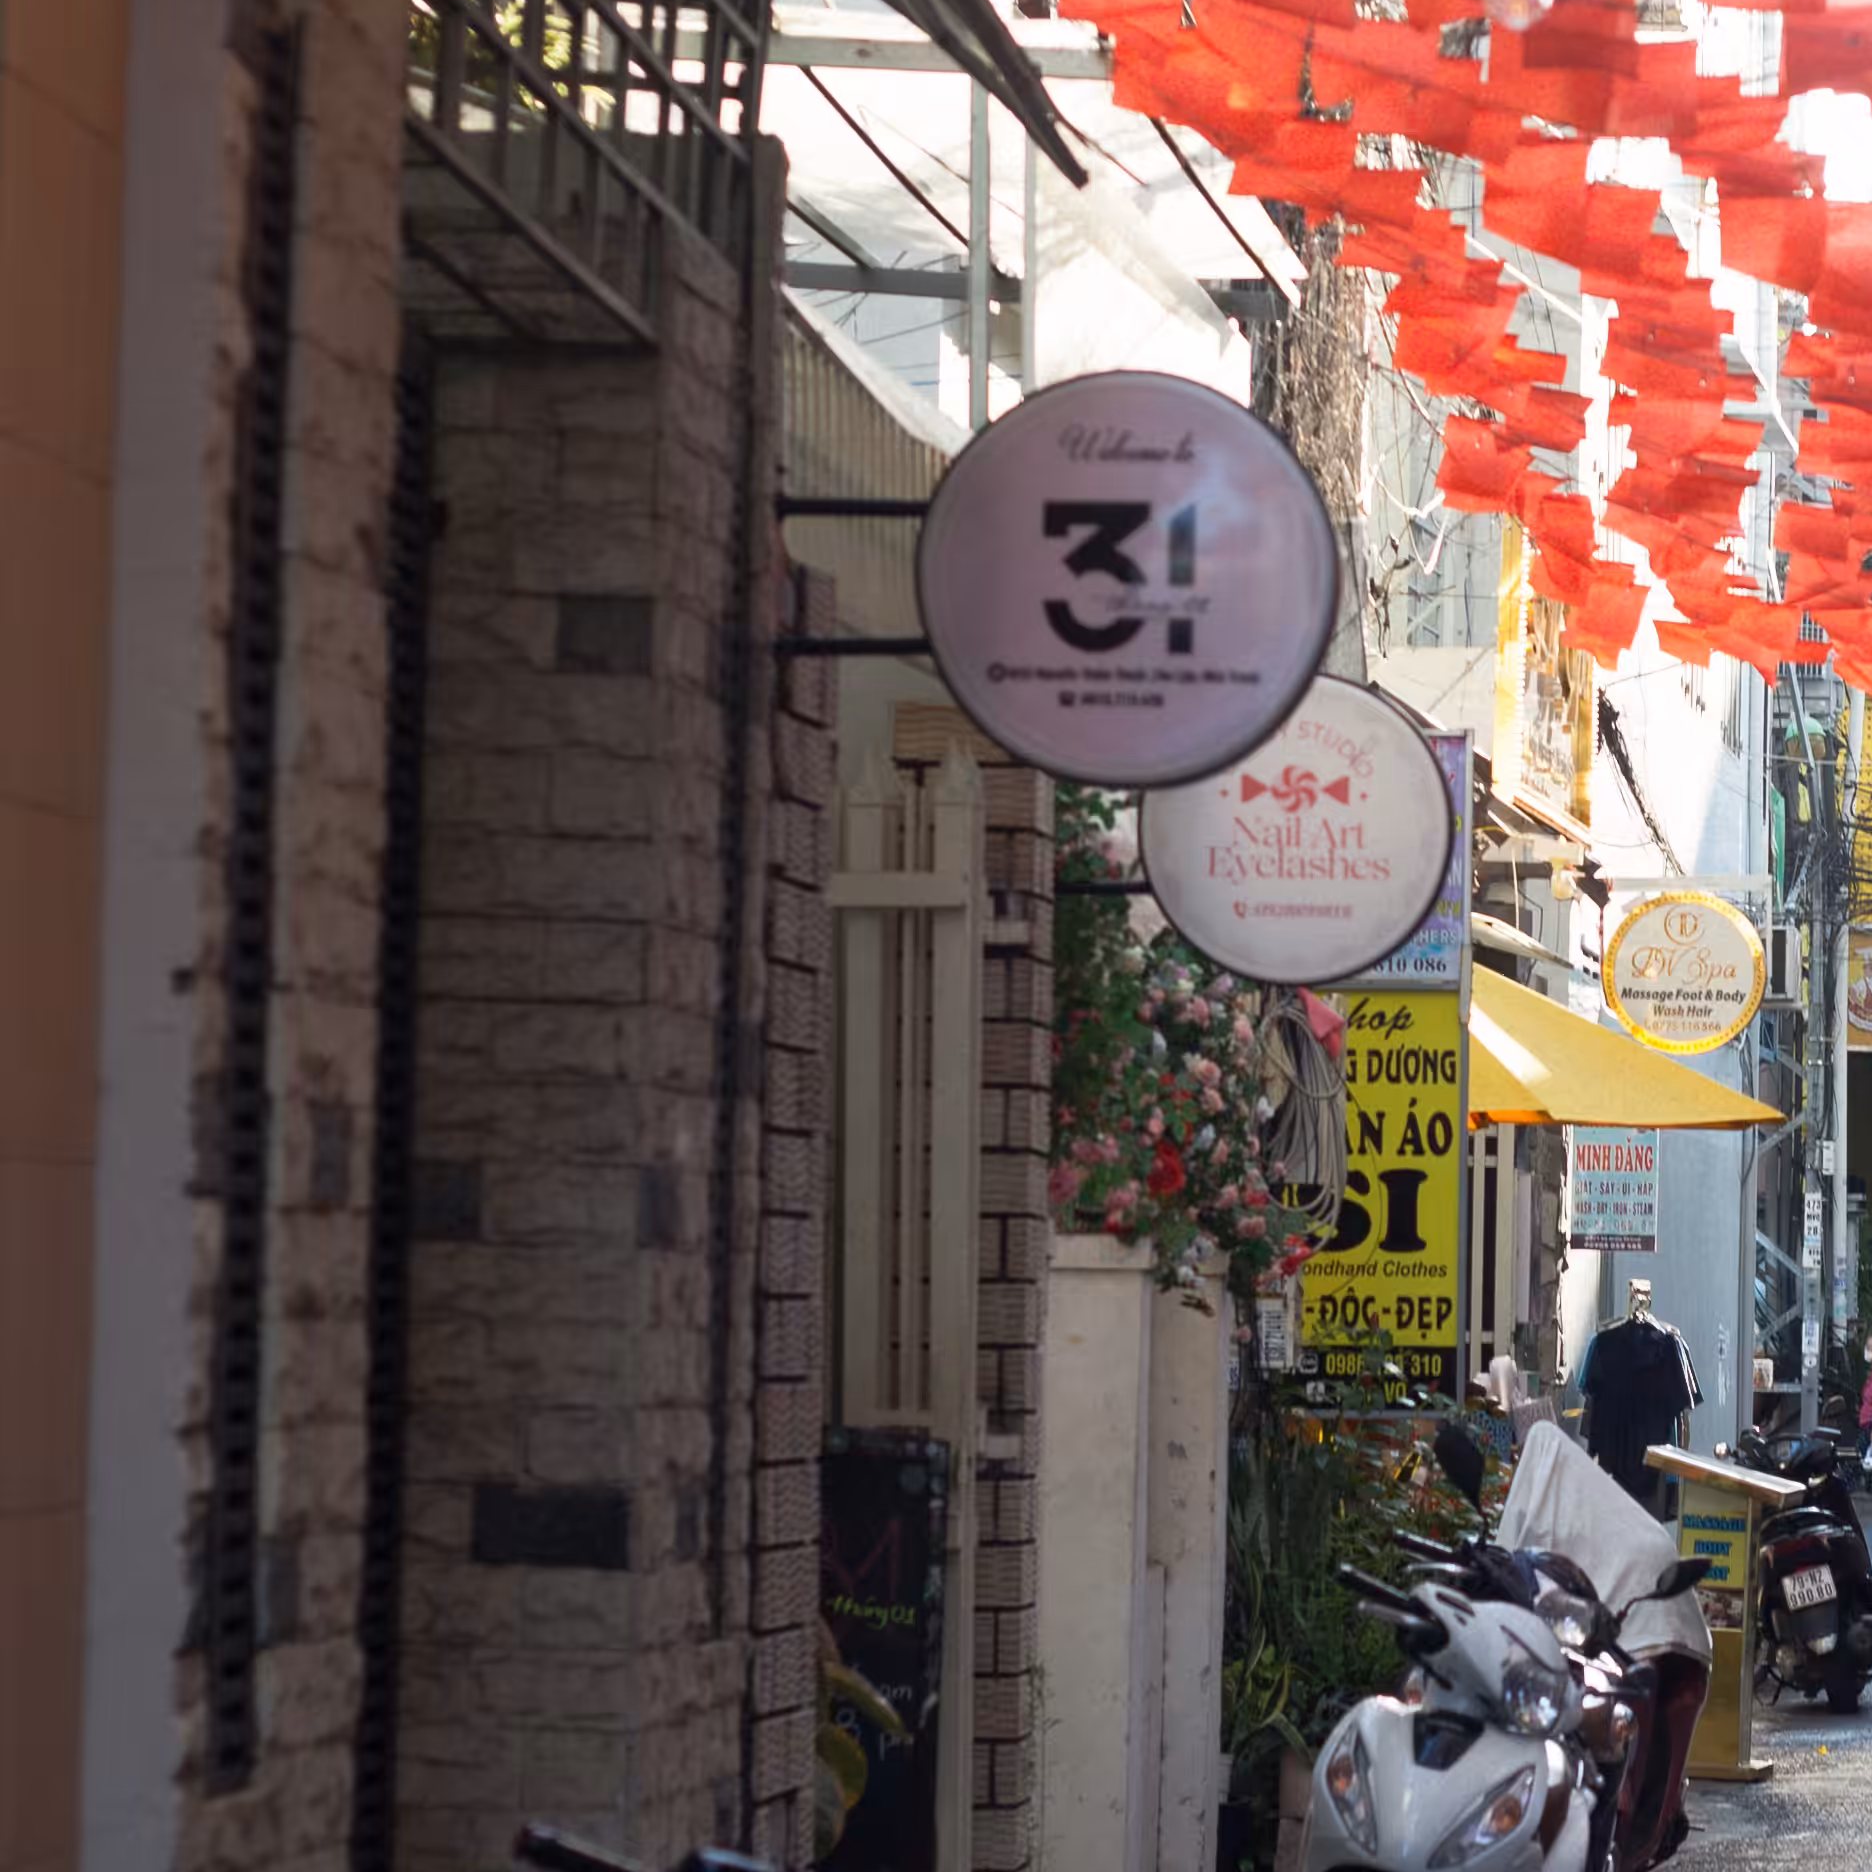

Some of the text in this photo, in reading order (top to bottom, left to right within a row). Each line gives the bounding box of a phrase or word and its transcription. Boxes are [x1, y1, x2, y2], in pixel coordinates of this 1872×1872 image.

[1043, 501, 1197, 654] 31
[1233, 815, 1364, 849] Nail Art
[1206, 846, 1391, 885] Eyelashes
[1413, 958, 1447, 973] 086
[1682, 945, 1737, 987] Spa
[1621, 986, 1674, 1003] Massage
[1676, 987, 1702, 1001] Foot
[1715, 989, 1747, 1005] Body
[1653, 1004, 1714, 1018] Wash Hair
[1347, 996, 1414, 1040] hop
[1366, 1043, 1457, 1085] DƯƠNG
[1397, 1097, 1453, 1157] ÁO
[1576, 1144, 1611, 1172] MINH
[1302, 1260, 1447, 1279] ondhand Clothes
